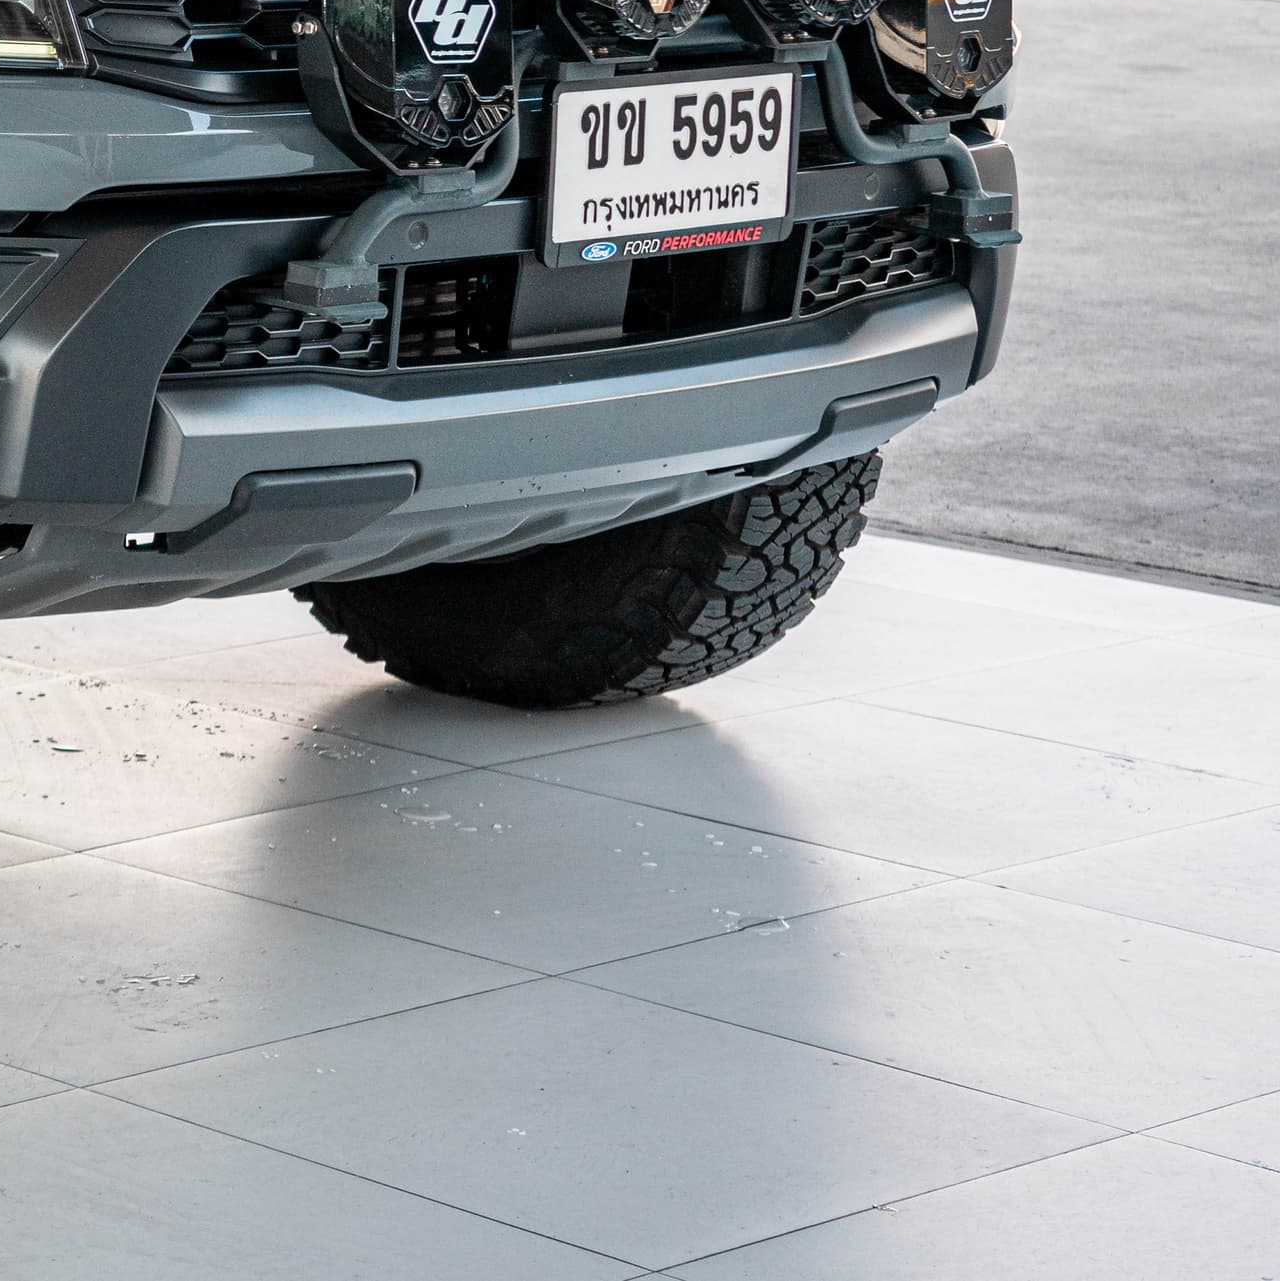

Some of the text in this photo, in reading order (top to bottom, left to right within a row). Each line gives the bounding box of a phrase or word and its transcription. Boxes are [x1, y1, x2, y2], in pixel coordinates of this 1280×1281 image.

[581, 86, 782, 170] ขข 5959
[583, 181, 760, 231] กรุงเทพมหานคร
[623, 239, 661, 256] FORD
[661, 226, 763, 251] PERFORMANCE
